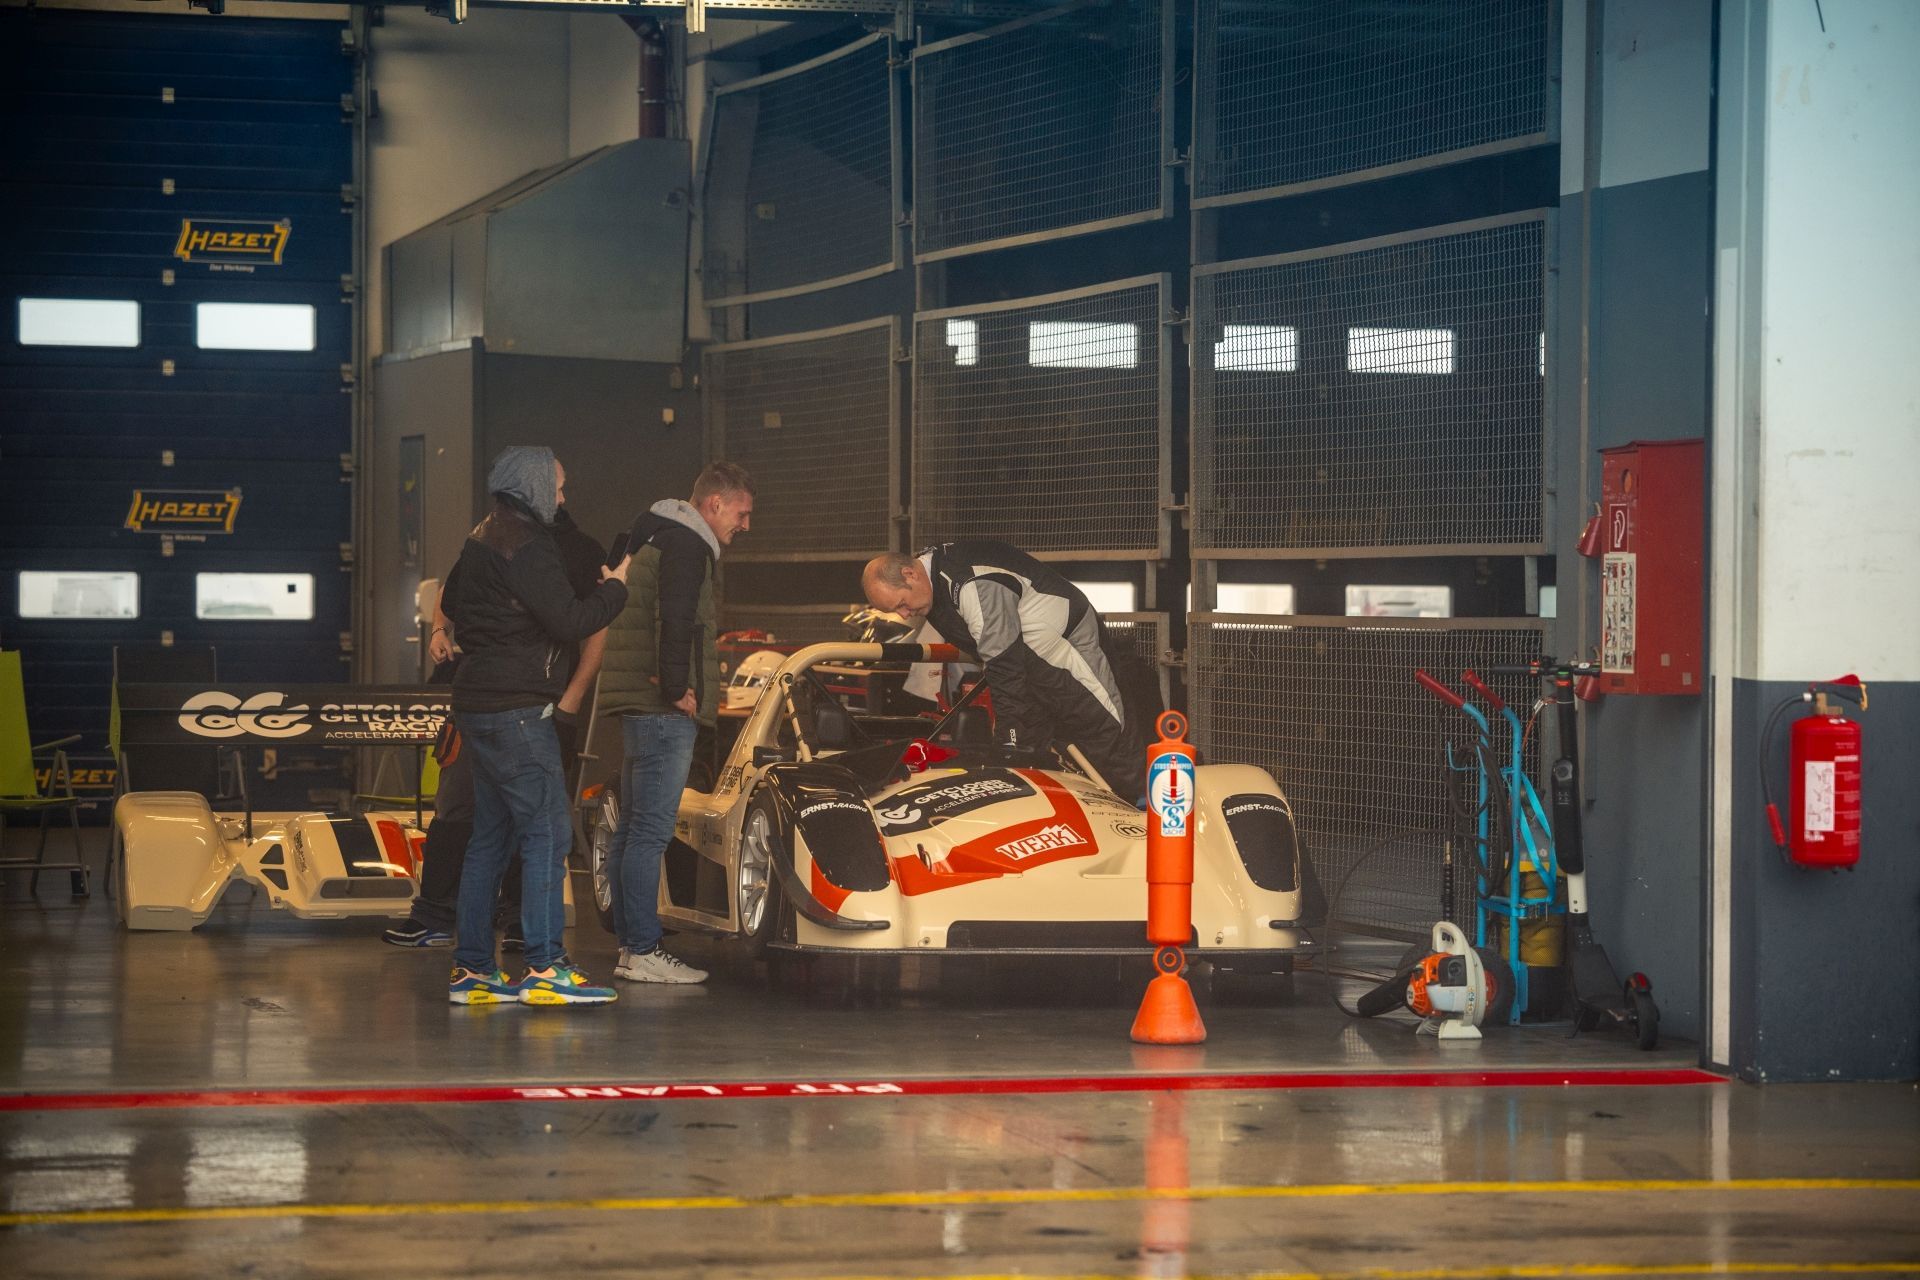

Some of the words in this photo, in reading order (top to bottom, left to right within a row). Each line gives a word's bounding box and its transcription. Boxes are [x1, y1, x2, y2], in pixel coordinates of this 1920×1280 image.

[188, 230, 277, 251] HAZET
[140, 501, 228, 521] HAZET
[320, 704, 451, 722] GETCLOS
[914, 779, 1005, 804] GETCLOSER
[949, 783, 1015, 801] RACING
[800, 802, 868, 818] ERNST-RACING
[1226, 803, 1289, 816] ERNST-RACING
[997, 824, 1086, 860] WERK1
